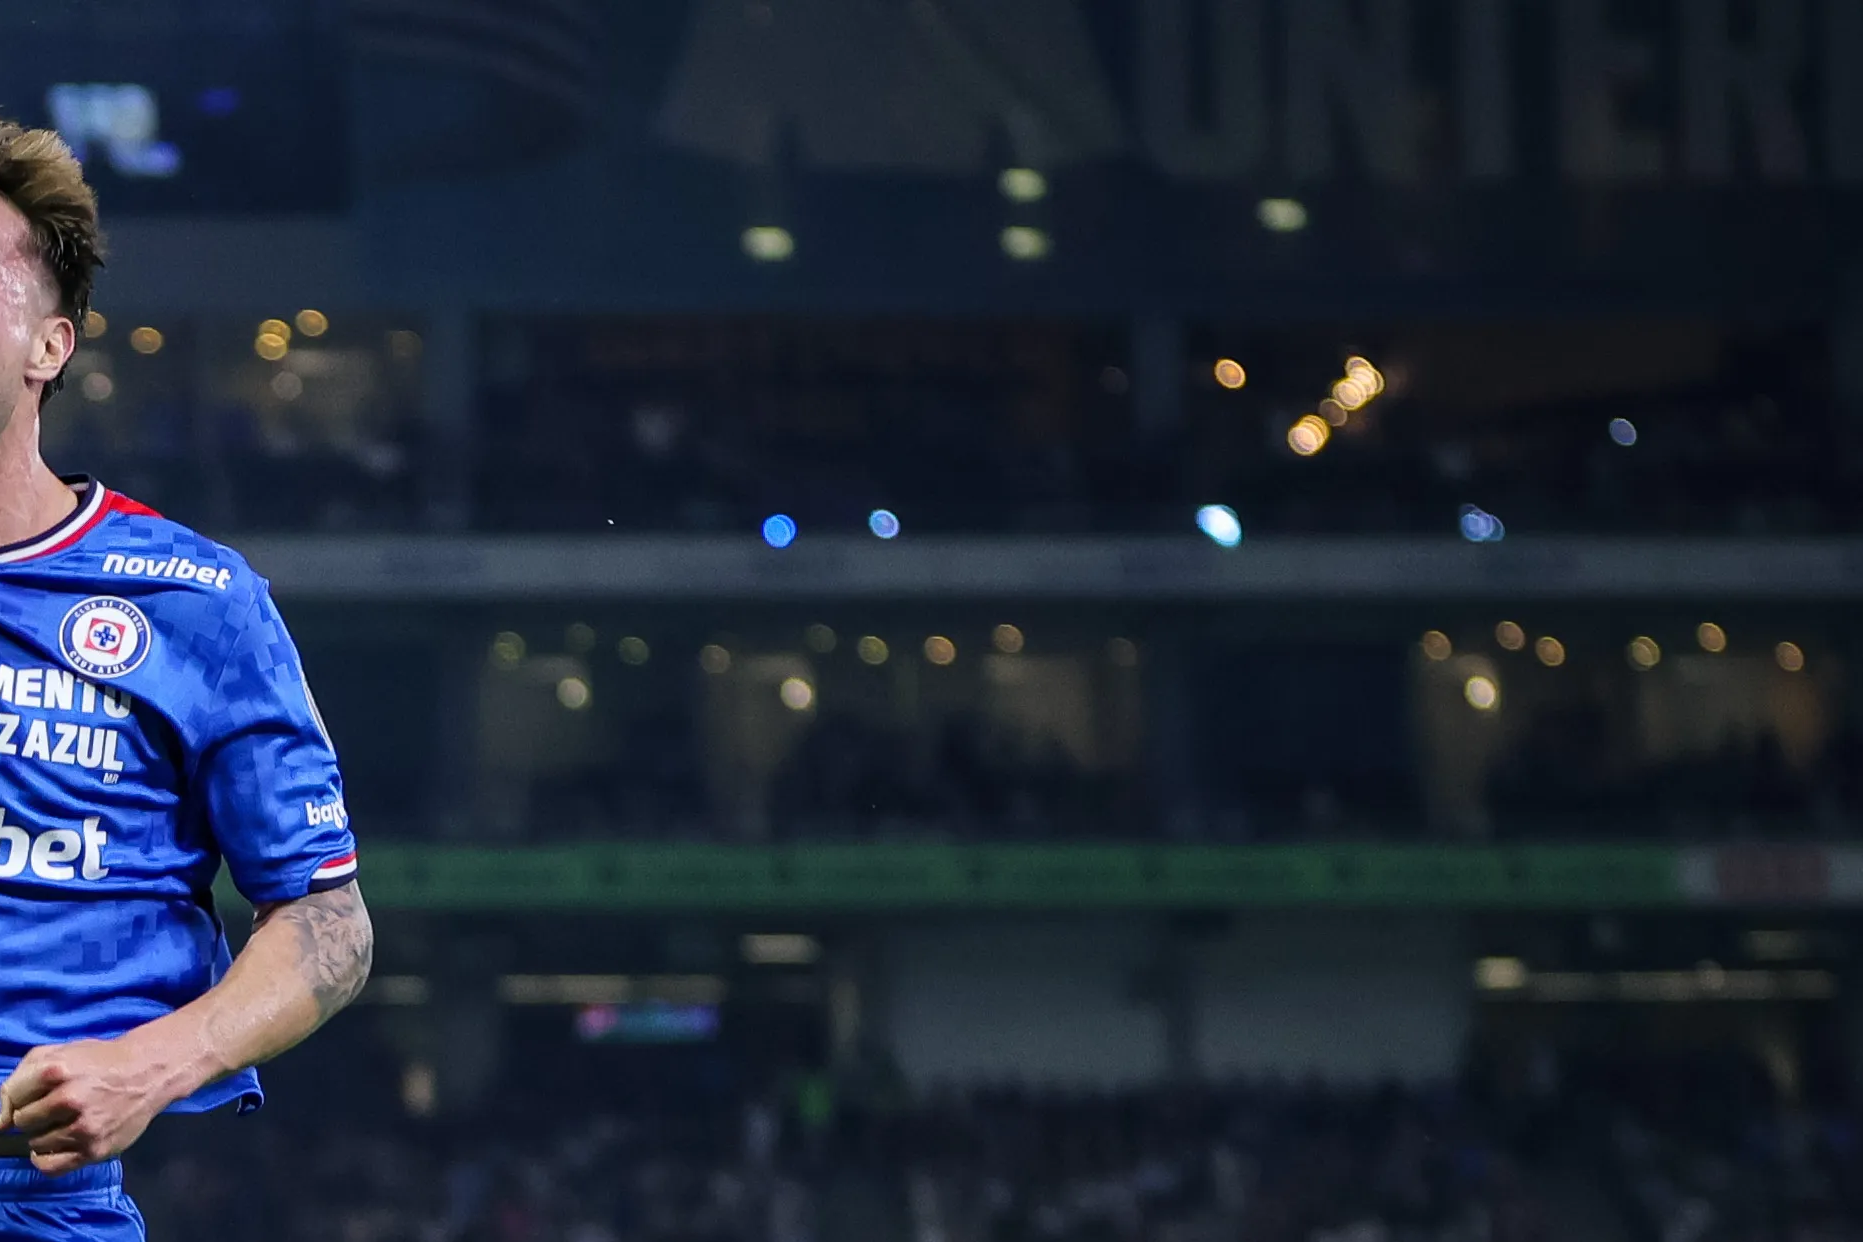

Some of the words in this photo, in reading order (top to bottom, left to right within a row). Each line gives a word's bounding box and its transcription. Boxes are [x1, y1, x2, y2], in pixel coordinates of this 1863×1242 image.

[102, 553, 232, 590] novibet
[74, 603, 97, 618] CLUB
[101, 600, 114, 608] DE
[69, 650, 95, 672] CRUZ
[97, 663, 127, 675] AZUL
[21, 719, 124, 772] AZUL
[103, 772, 120, 785] MR
